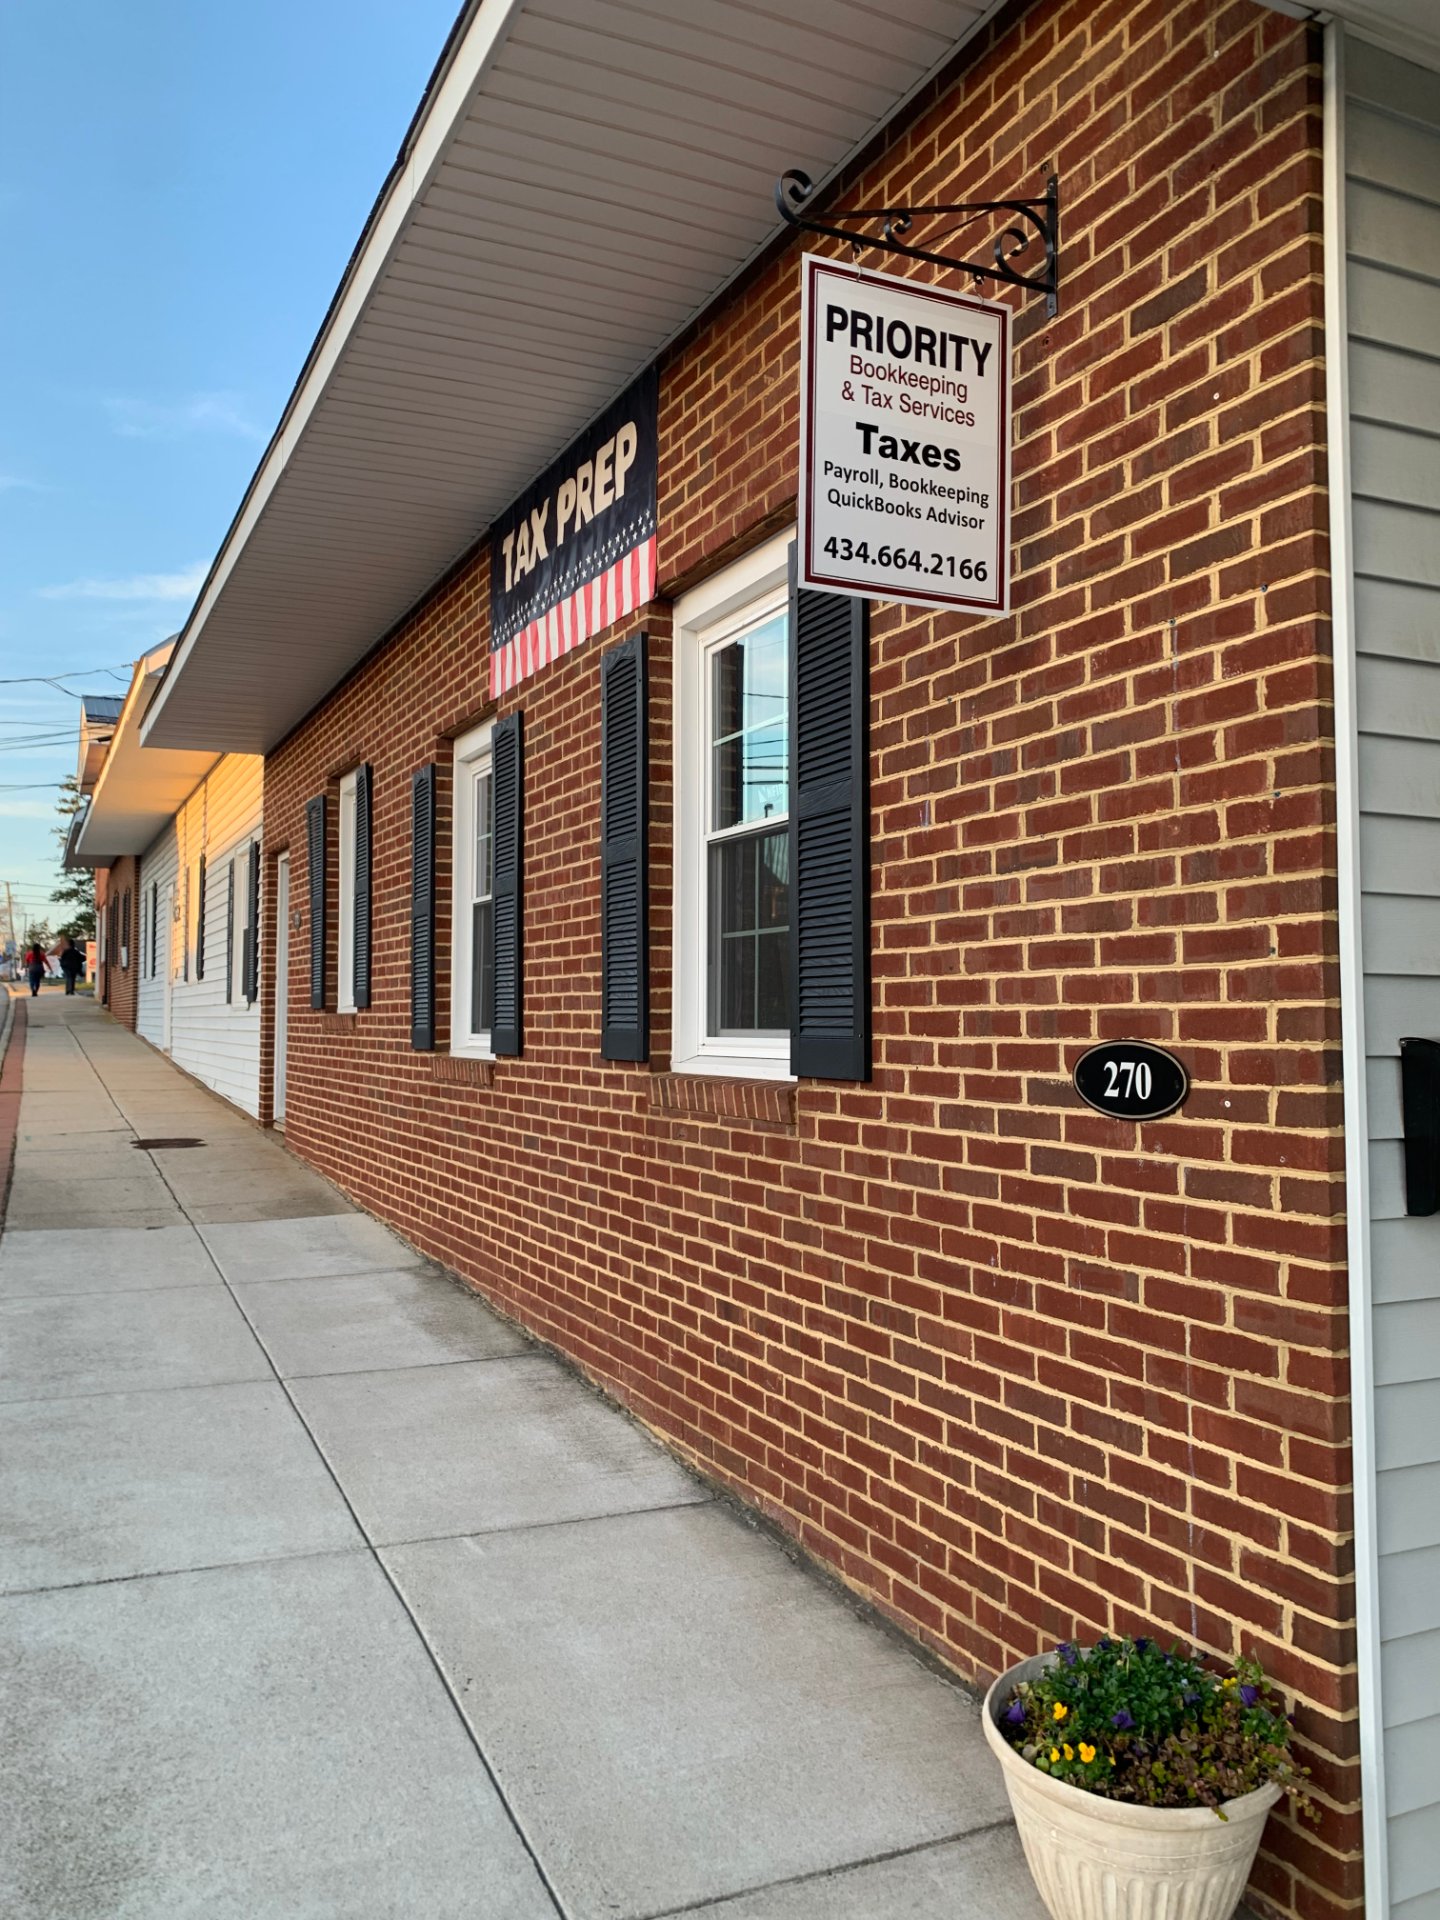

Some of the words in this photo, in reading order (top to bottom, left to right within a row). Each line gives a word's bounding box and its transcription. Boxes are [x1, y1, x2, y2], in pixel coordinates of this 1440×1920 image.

[826, 304, 992, 377] PRIORITY
[850, 354, 968, 403] Bookkeeping
[841, 380, 855, 402] &
[861, 384, 893, 410] Tax
[899, 393, 975, 427] Services
[855, 421, 961, 472] Taxes
[502, 496, 550, 593] TAX
[556, 421, 638, 547] PREP
[824, 460, 884, 489] Payroll,
[889, 473, 989, 509] Bookkeeping
[827, 488, 922, 519] QuickBooks
[926, 506, 985, 530] Advisor
[823, 536, 988, 582] 434.664.2166
[1103, 1061, 1152, 1100] 270
